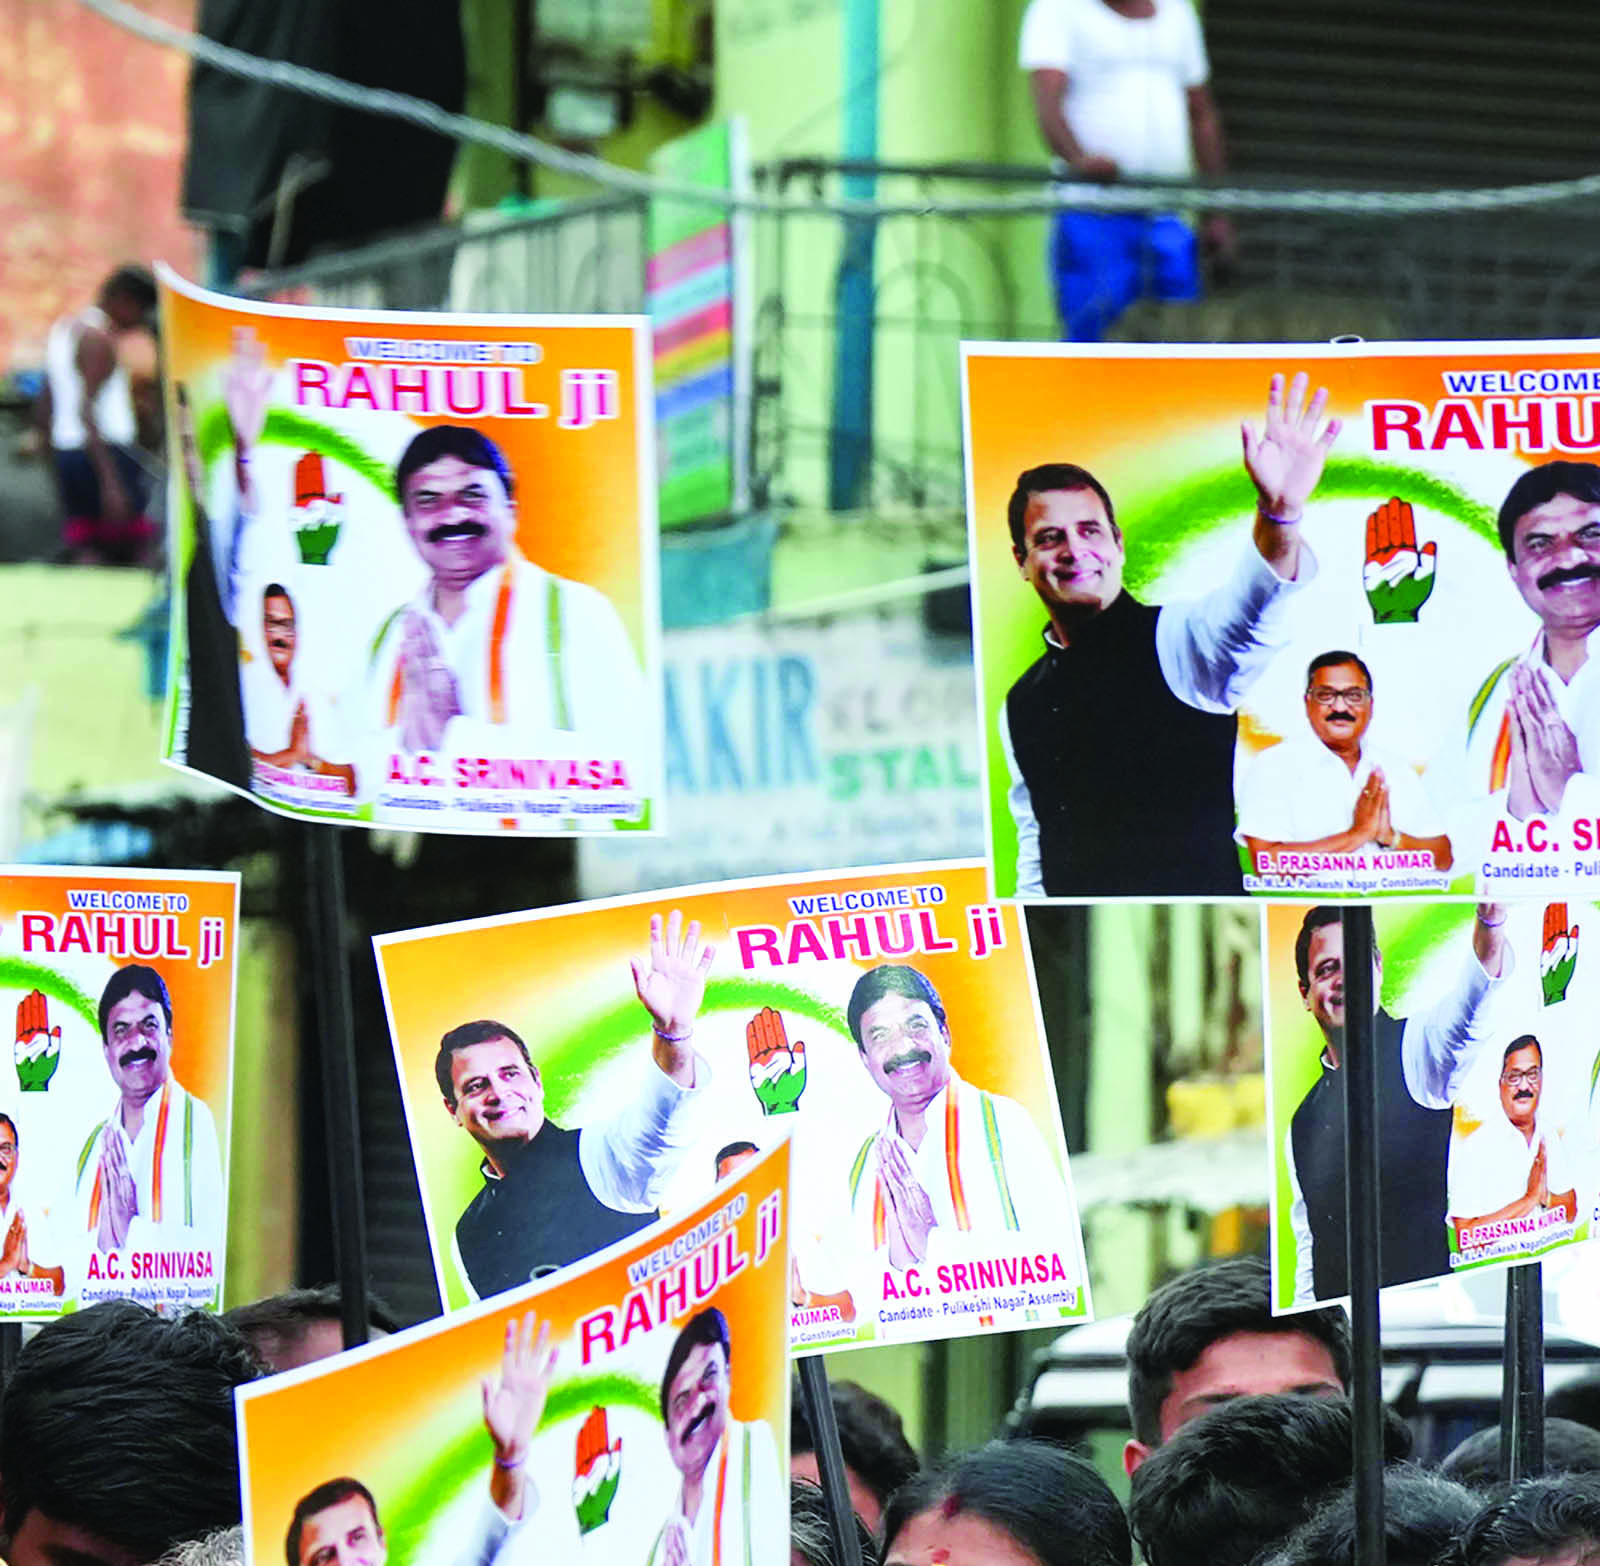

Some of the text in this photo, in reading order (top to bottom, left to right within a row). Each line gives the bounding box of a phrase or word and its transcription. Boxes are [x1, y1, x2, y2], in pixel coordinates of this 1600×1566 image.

[350, 338, 489, 362] WELCOME
[294, 361, 615, 425] RAHUL ji
[1491, 820, 1558, 852] A.C.
[1259, 853, 1432, 871] B. PRASANNA KUMAR
[1482, 862, 1559, 878] Candidate
[1299, 878, 1345, 889] Pulikeshi
[1347, 879, 1376, 892] Nagar
[1381, 878, 1449, 890] Constituency
[71, 892, 187, 911] WELCOME TO
[792, 886, 944, 916] WELCOME TO
[22, 913, 222, 966] RAHUL ji
[737, 907, 1003, 970] RAHUL ji
[630, 1195, 745, 1283] WELCOME TO
[88, 1251, 213, 1280] A.C. SRINIVASA
[581, 1196, 779, 1364] RAHUL ji
[882, 1253, 1065, 1300] A.C. SRINIVASA
[15, 1280, 52, 1294] KUMAR
[791, 1306, 840, 1327] KUMAR
[878, 1288, 1076, 1323] Candidate Pulikeshi Nagar Assembly
